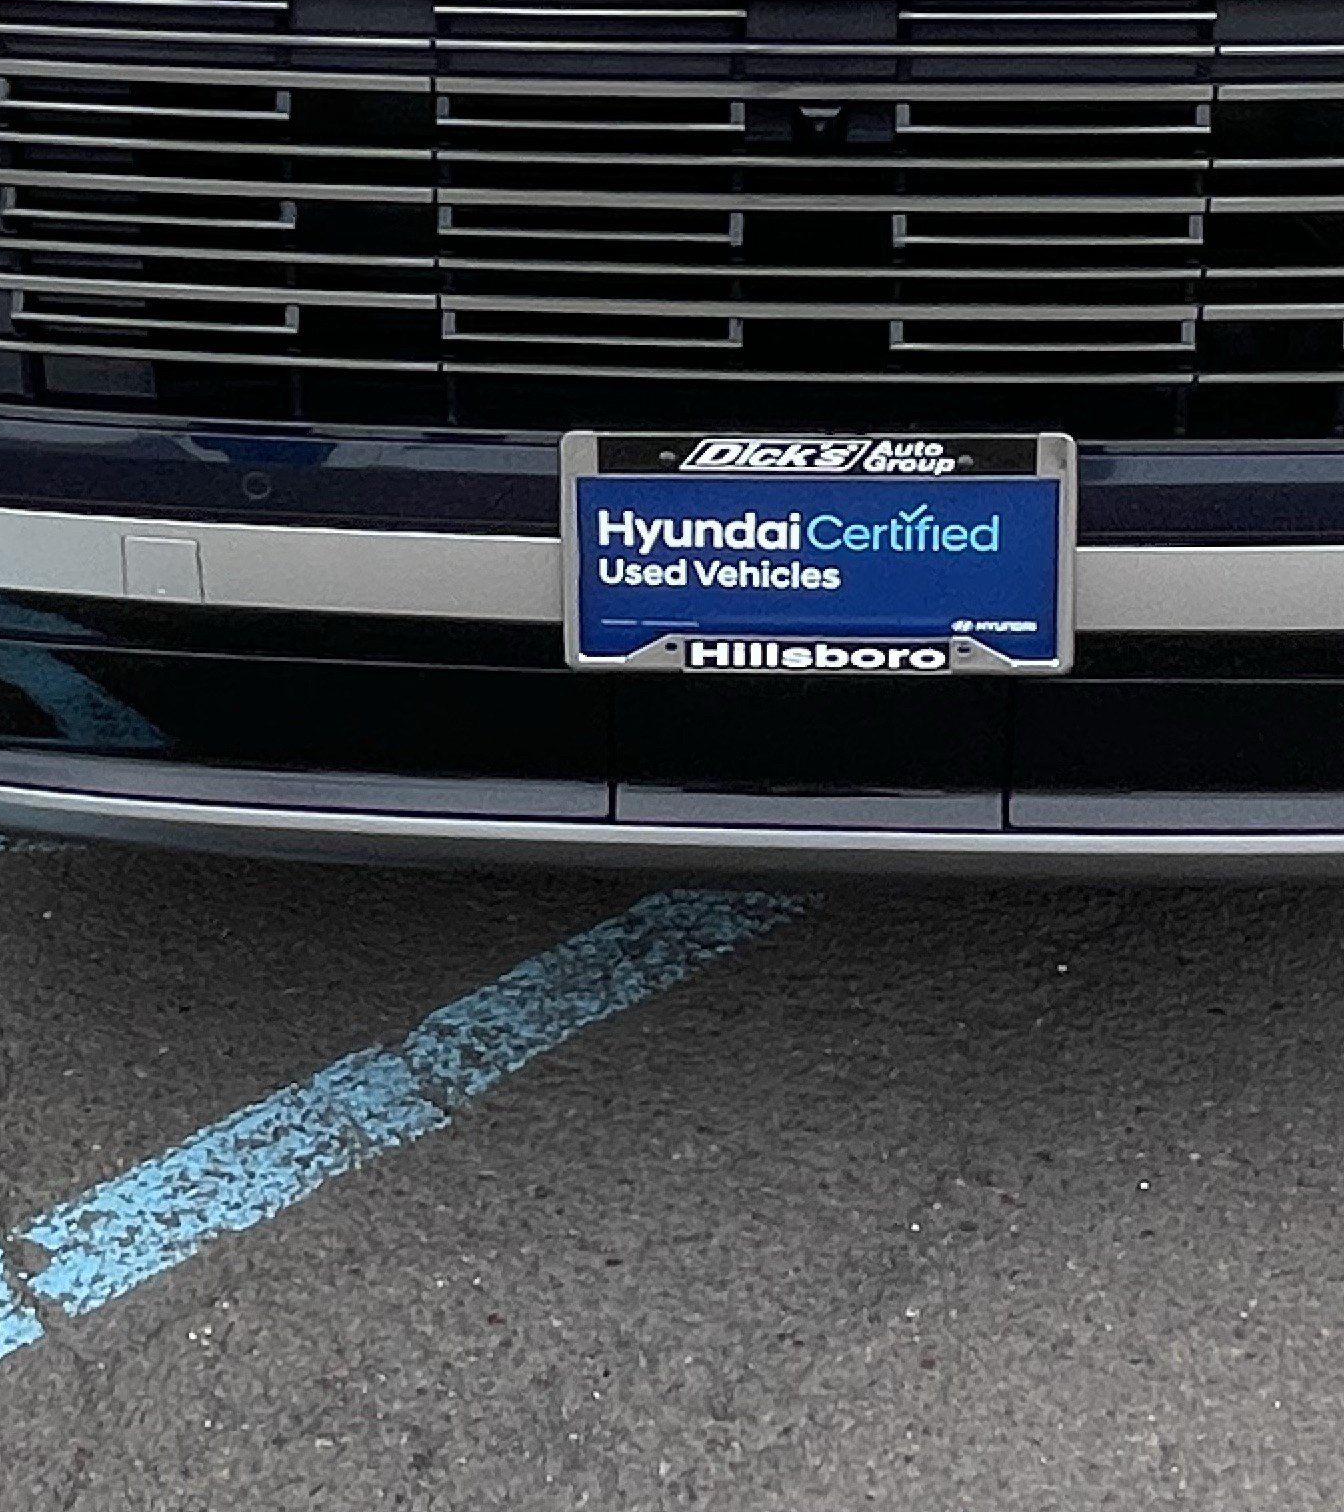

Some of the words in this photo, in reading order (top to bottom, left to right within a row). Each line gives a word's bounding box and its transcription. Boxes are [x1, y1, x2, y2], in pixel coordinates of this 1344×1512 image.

[869, 440, 944, 456] Auto
[863, 455, 956, 476] Group
[598, 510, 801, 554] Hyundai
[806, 504, 1000, 551] Certified
[599, 558, 688, 587] Used
[692, 560, 842, 590] Vehicles
[691, 642, 946, 670] Hillsboro
